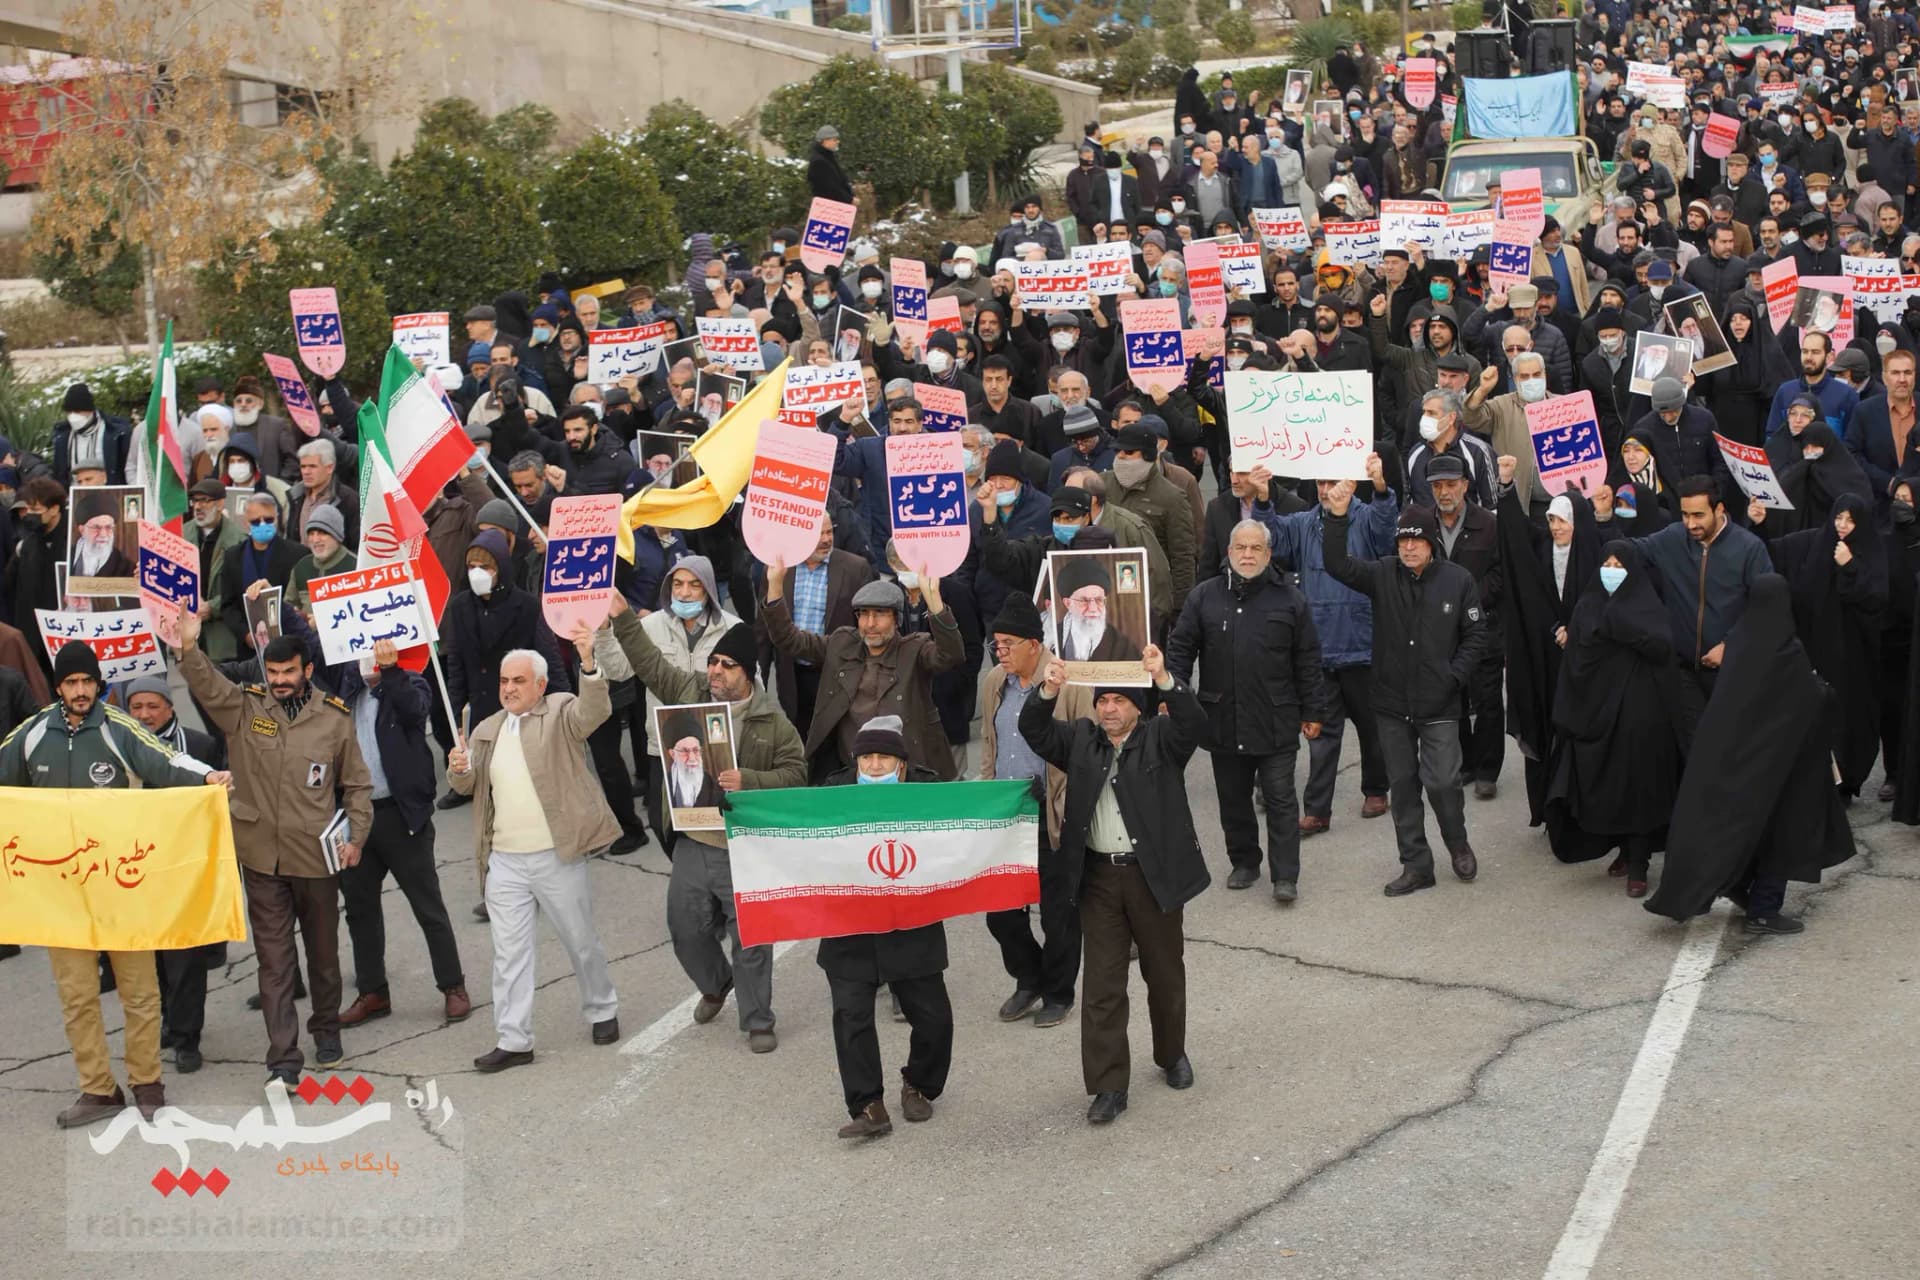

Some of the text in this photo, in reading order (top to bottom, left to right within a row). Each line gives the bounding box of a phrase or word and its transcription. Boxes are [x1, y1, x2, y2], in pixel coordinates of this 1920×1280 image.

[810, 223, 846, 239] مرگ بر
[1396, 235, 1435, 247] رهبیم
[1505, 245, 1527, 260] مرگ
[1065, 278, 1088, 291] مرگ
[905, 288, 924, 303] مرگ
[301, 315, 336, 331] مرگ بر
[1131, 332, 1177, 350] مرگ بر
[600, 342, 657, 363] مطیع امر
[1131, 350, 1180, 367] امریکا
[608, 361, 651, 378] رهبیم
[835, 369, 858, 380] مرگ
[840, 382, 863, 399] مرگ
[778, 411, 793, 423] آخ
[935, 413, 962, 431] مرگ
[1285, 407, 1327, 424] است
[1290, 431, 1312, 461] او
[1317, 427, 1364, 456] دشمن
[1541, 425, 1591, 452] مرگ بر
[1541, 440, 1597, 467] امریکا
[818, 479, 827, 492] تا
[898, 474, 957, 501] مرگ بر
[750, 492, 769, 506] WE
[751, 506, 814, 531] TO THE END
[897, 500, 961, 526] امریکا
[894, 531, 919, 541] DOWN
[920, 531, 940, 540] WITH
[552, 538, 608, 566] مرگ بر
[145, 557, 193, 587] مرگ بر
[390, 565, 401, 580] تا
[550, 563, 608, 589] امریکا
[330, 590, 417, 630] مطیع امر
[45, 616, 143, 637] مرگ بر آمریکا
[101, 644, 116, 661] بر
[117, 638, 154, 655] مرگ
[121, 659, 157, 673] مرگ
[114, 838, 156, 889] مطیع
